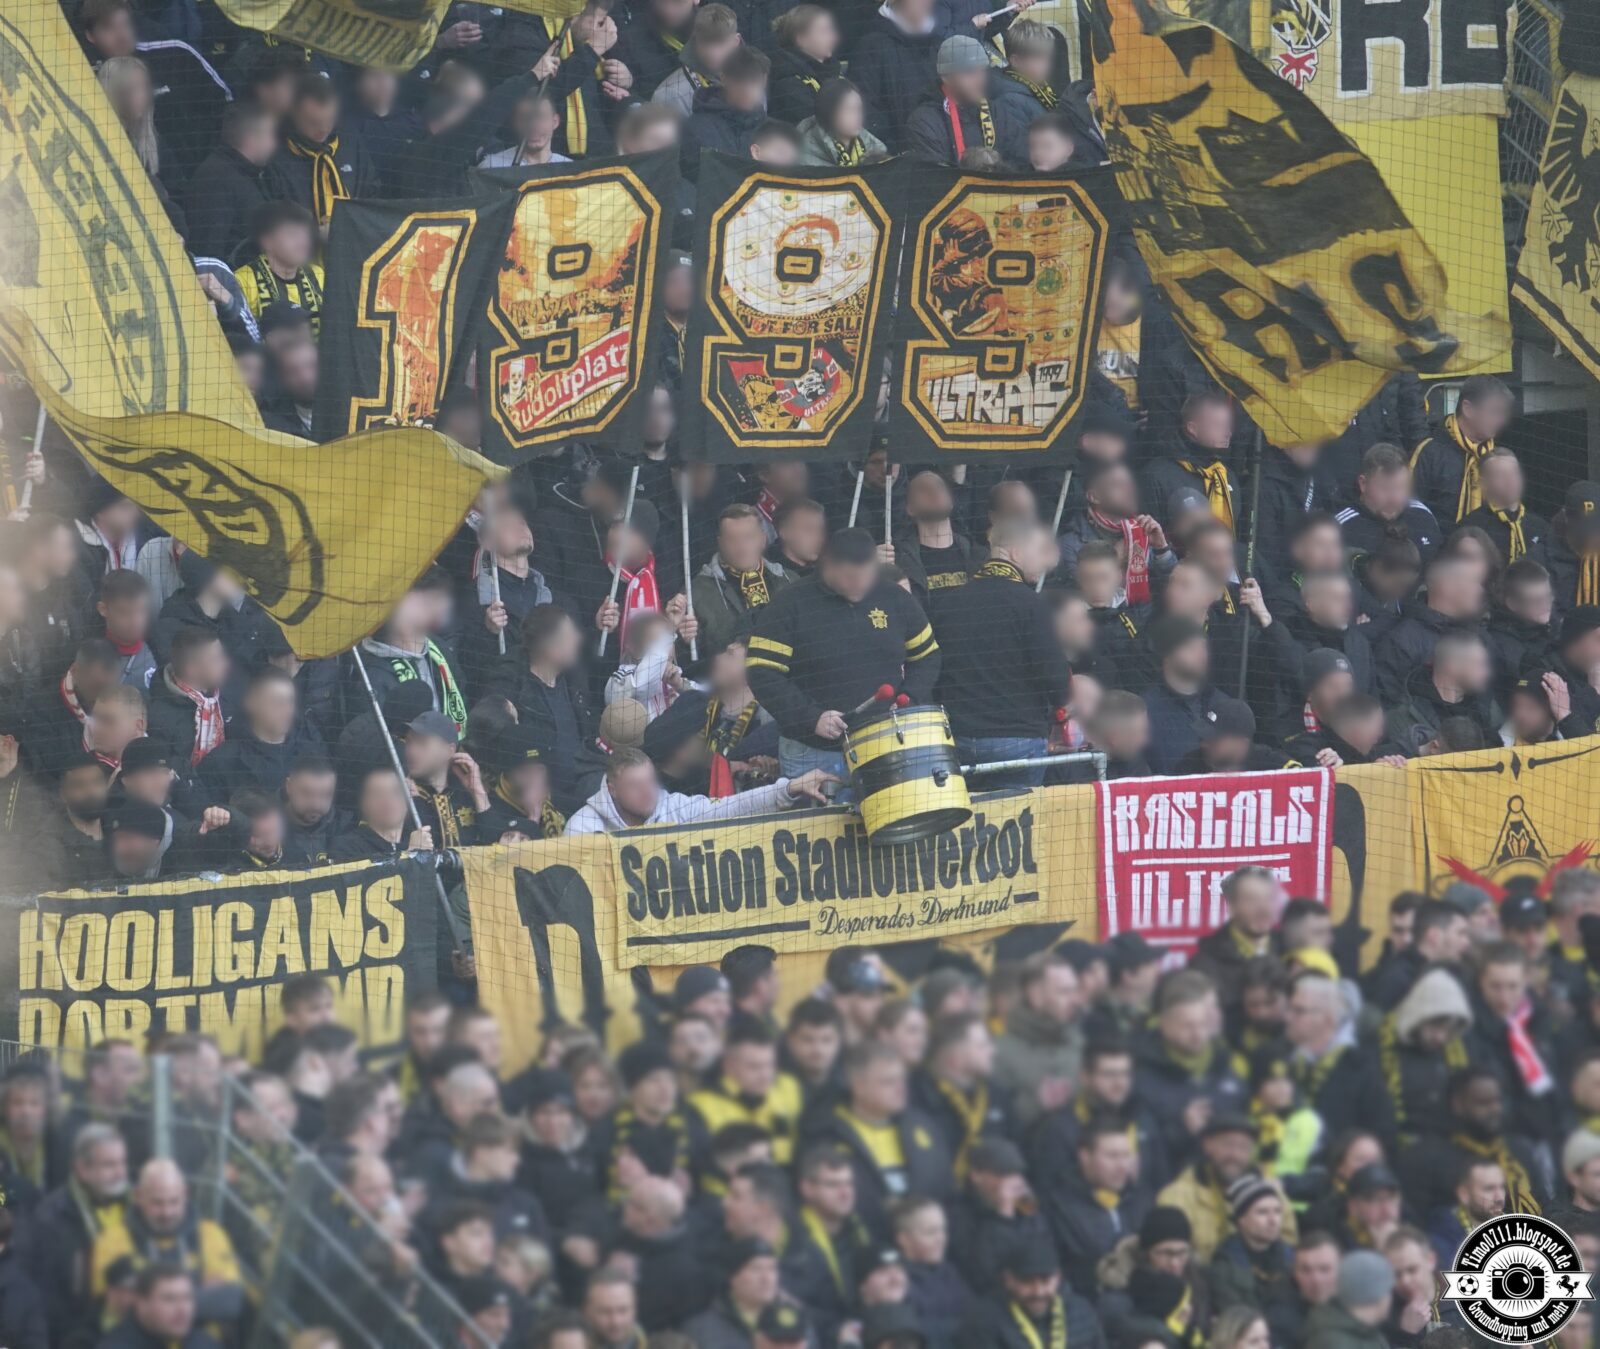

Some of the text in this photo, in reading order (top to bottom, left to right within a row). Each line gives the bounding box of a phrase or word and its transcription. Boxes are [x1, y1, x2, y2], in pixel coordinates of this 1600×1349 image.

[619, 806, 1038, 922] Sektion Stadionverbot
[1113, 786, 1315, 853] RASCALS
[18, 873, 405, 992] HOOLIGANS
[815, 885, 1013, 941] Desperados Dortmund
